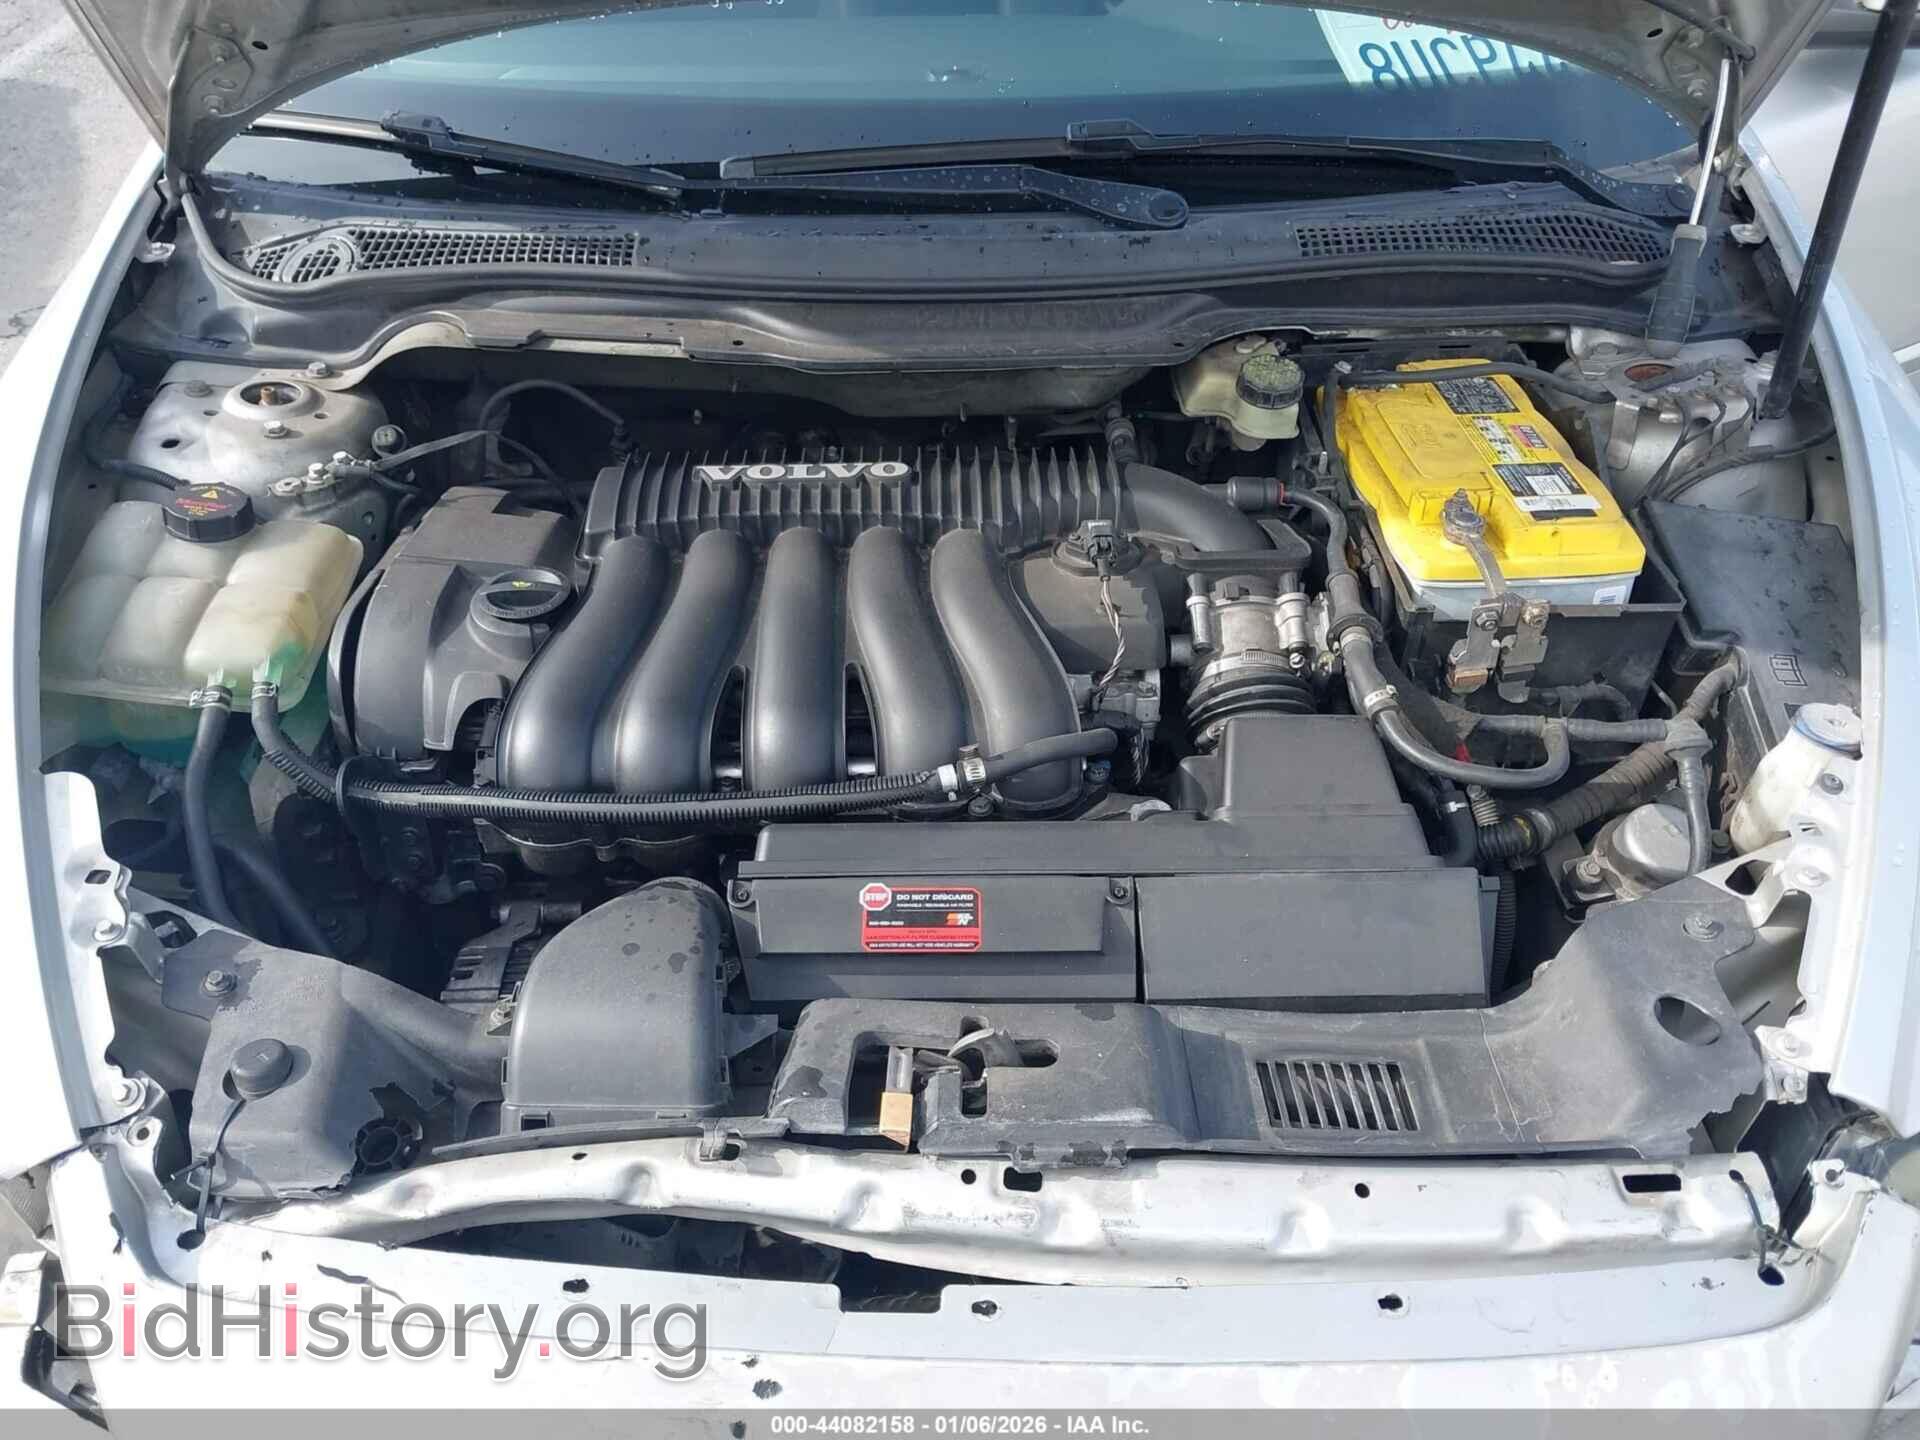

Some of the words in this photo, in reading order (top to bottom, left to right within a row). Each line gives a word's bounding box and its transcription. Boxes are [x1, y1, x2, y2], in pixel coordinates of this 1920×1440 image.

[696, 461, 909, 480] VOLVO
[896, 893, 910, 901] DO
[911, 893, 931, 901] NOT
[932, 893, 974, 901] DISCARD
